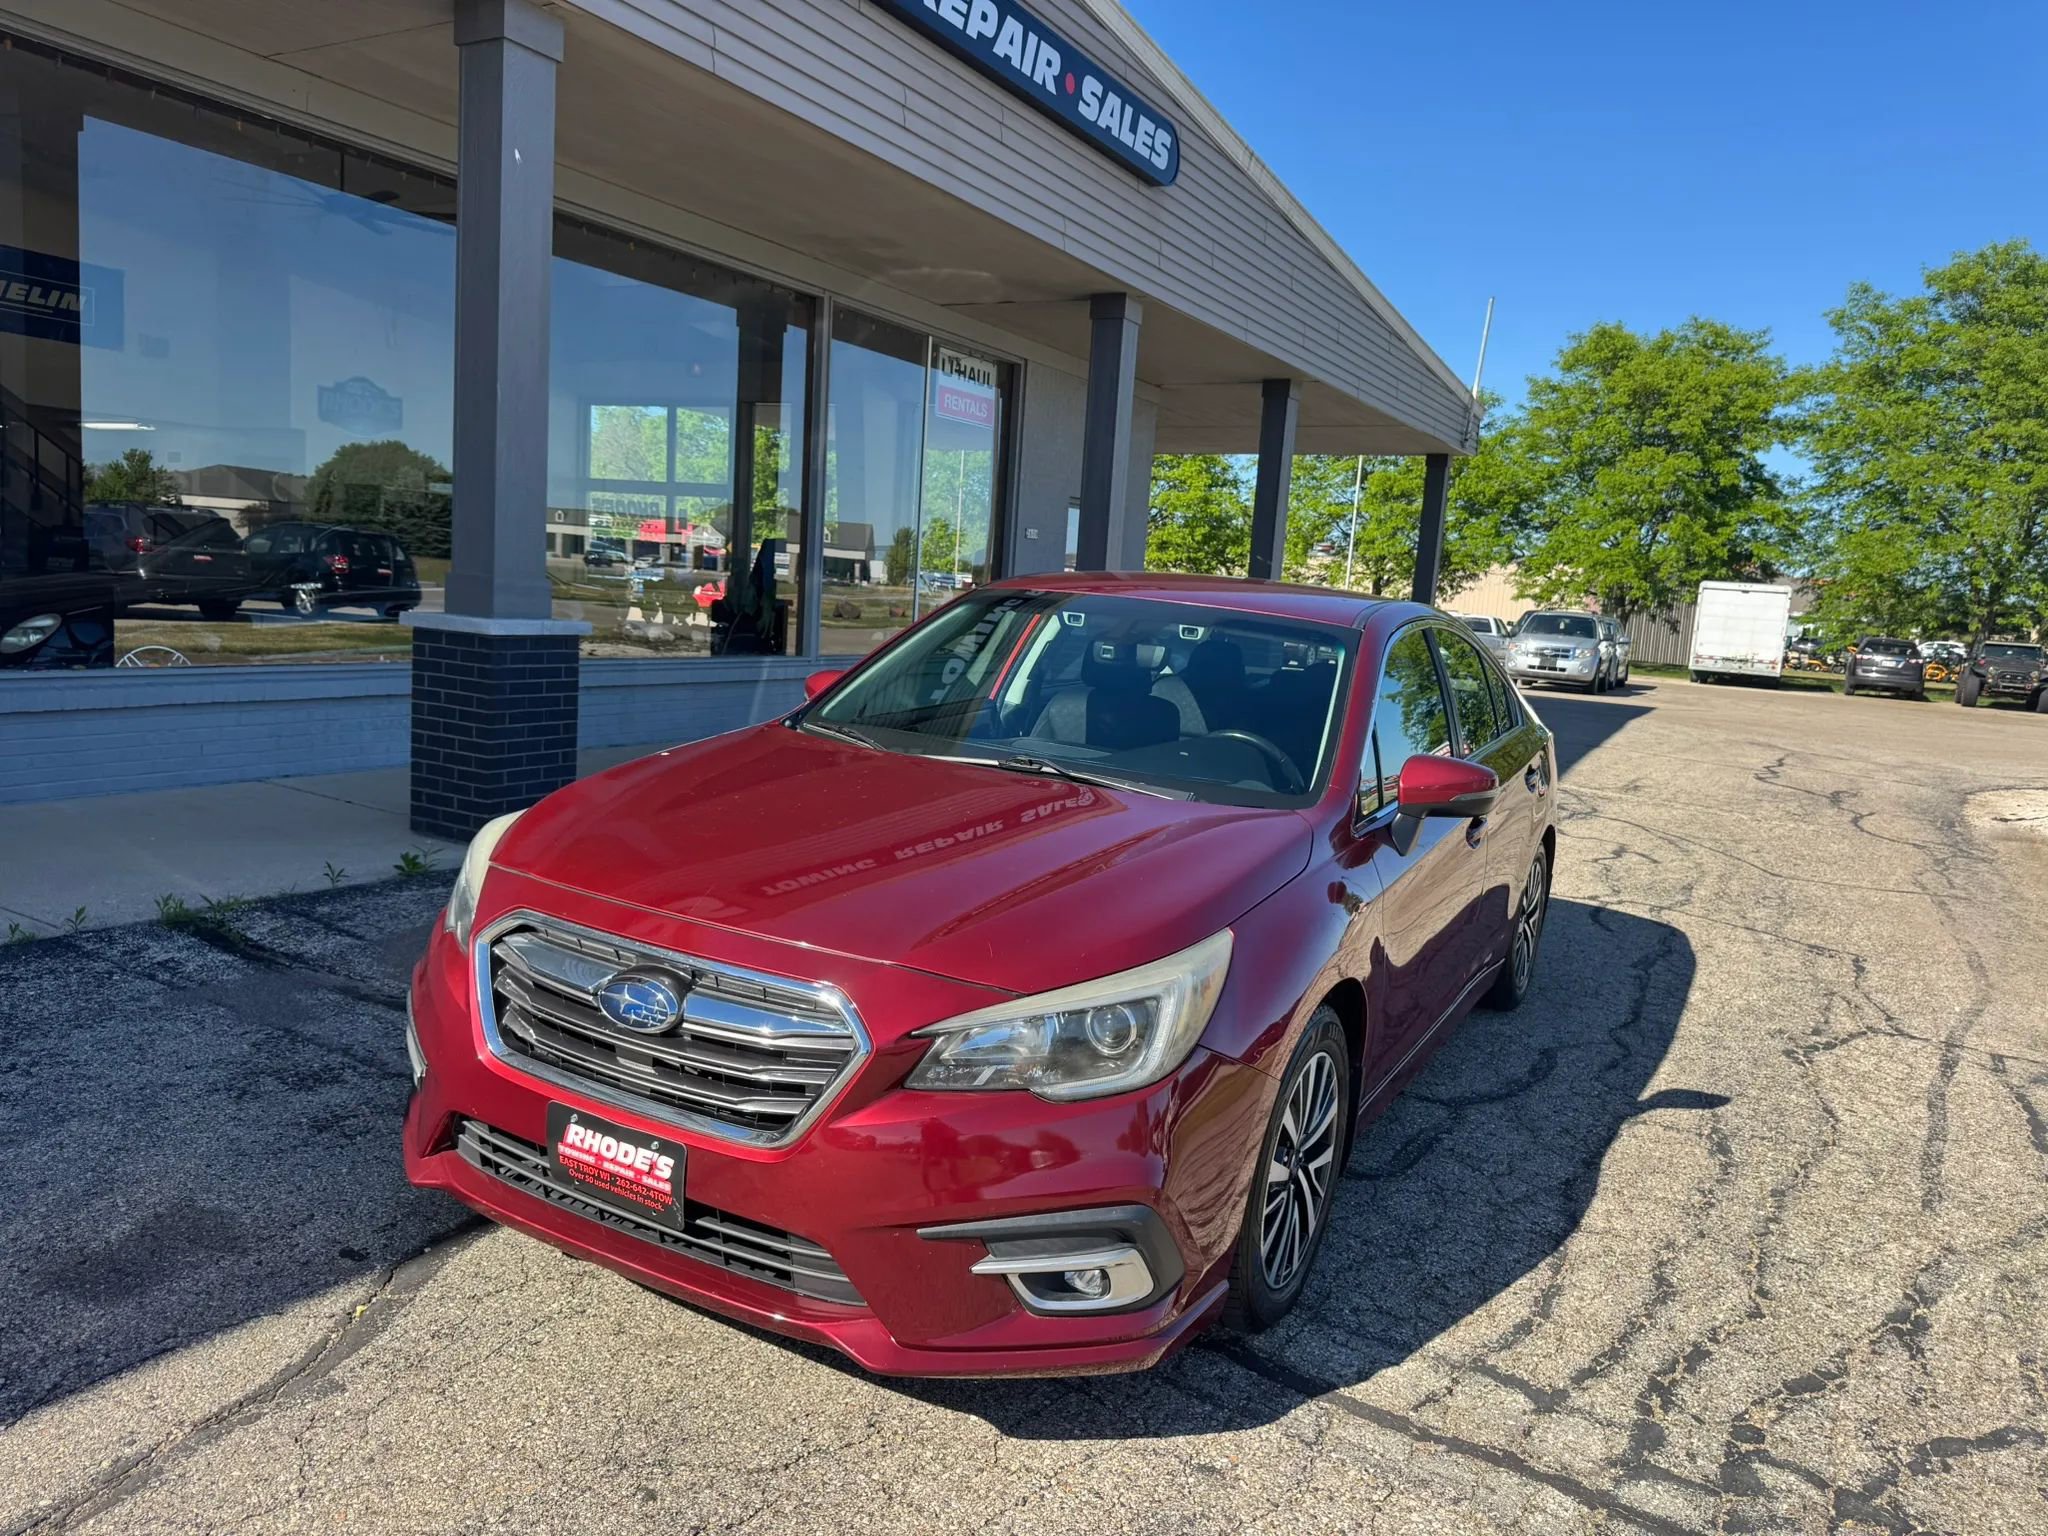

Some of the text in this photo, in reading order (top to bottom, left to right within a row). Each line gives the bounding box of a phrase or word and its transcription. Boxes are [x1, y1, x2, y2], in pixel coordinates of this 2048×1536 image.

[1077, 75, 1171, 170] SALES
[944, 393, 988, 417] RENTALS
[558, 1145, 672, 1191] TOWING REPAIR SALES
[564, 1123, 675, 1180] RHODE'S
[559, 1156, 673, 1206] EAST TROY WI 262-642-4TOW
[569, 1168, 665, 1211] Over 50 used vehicles in stock.
